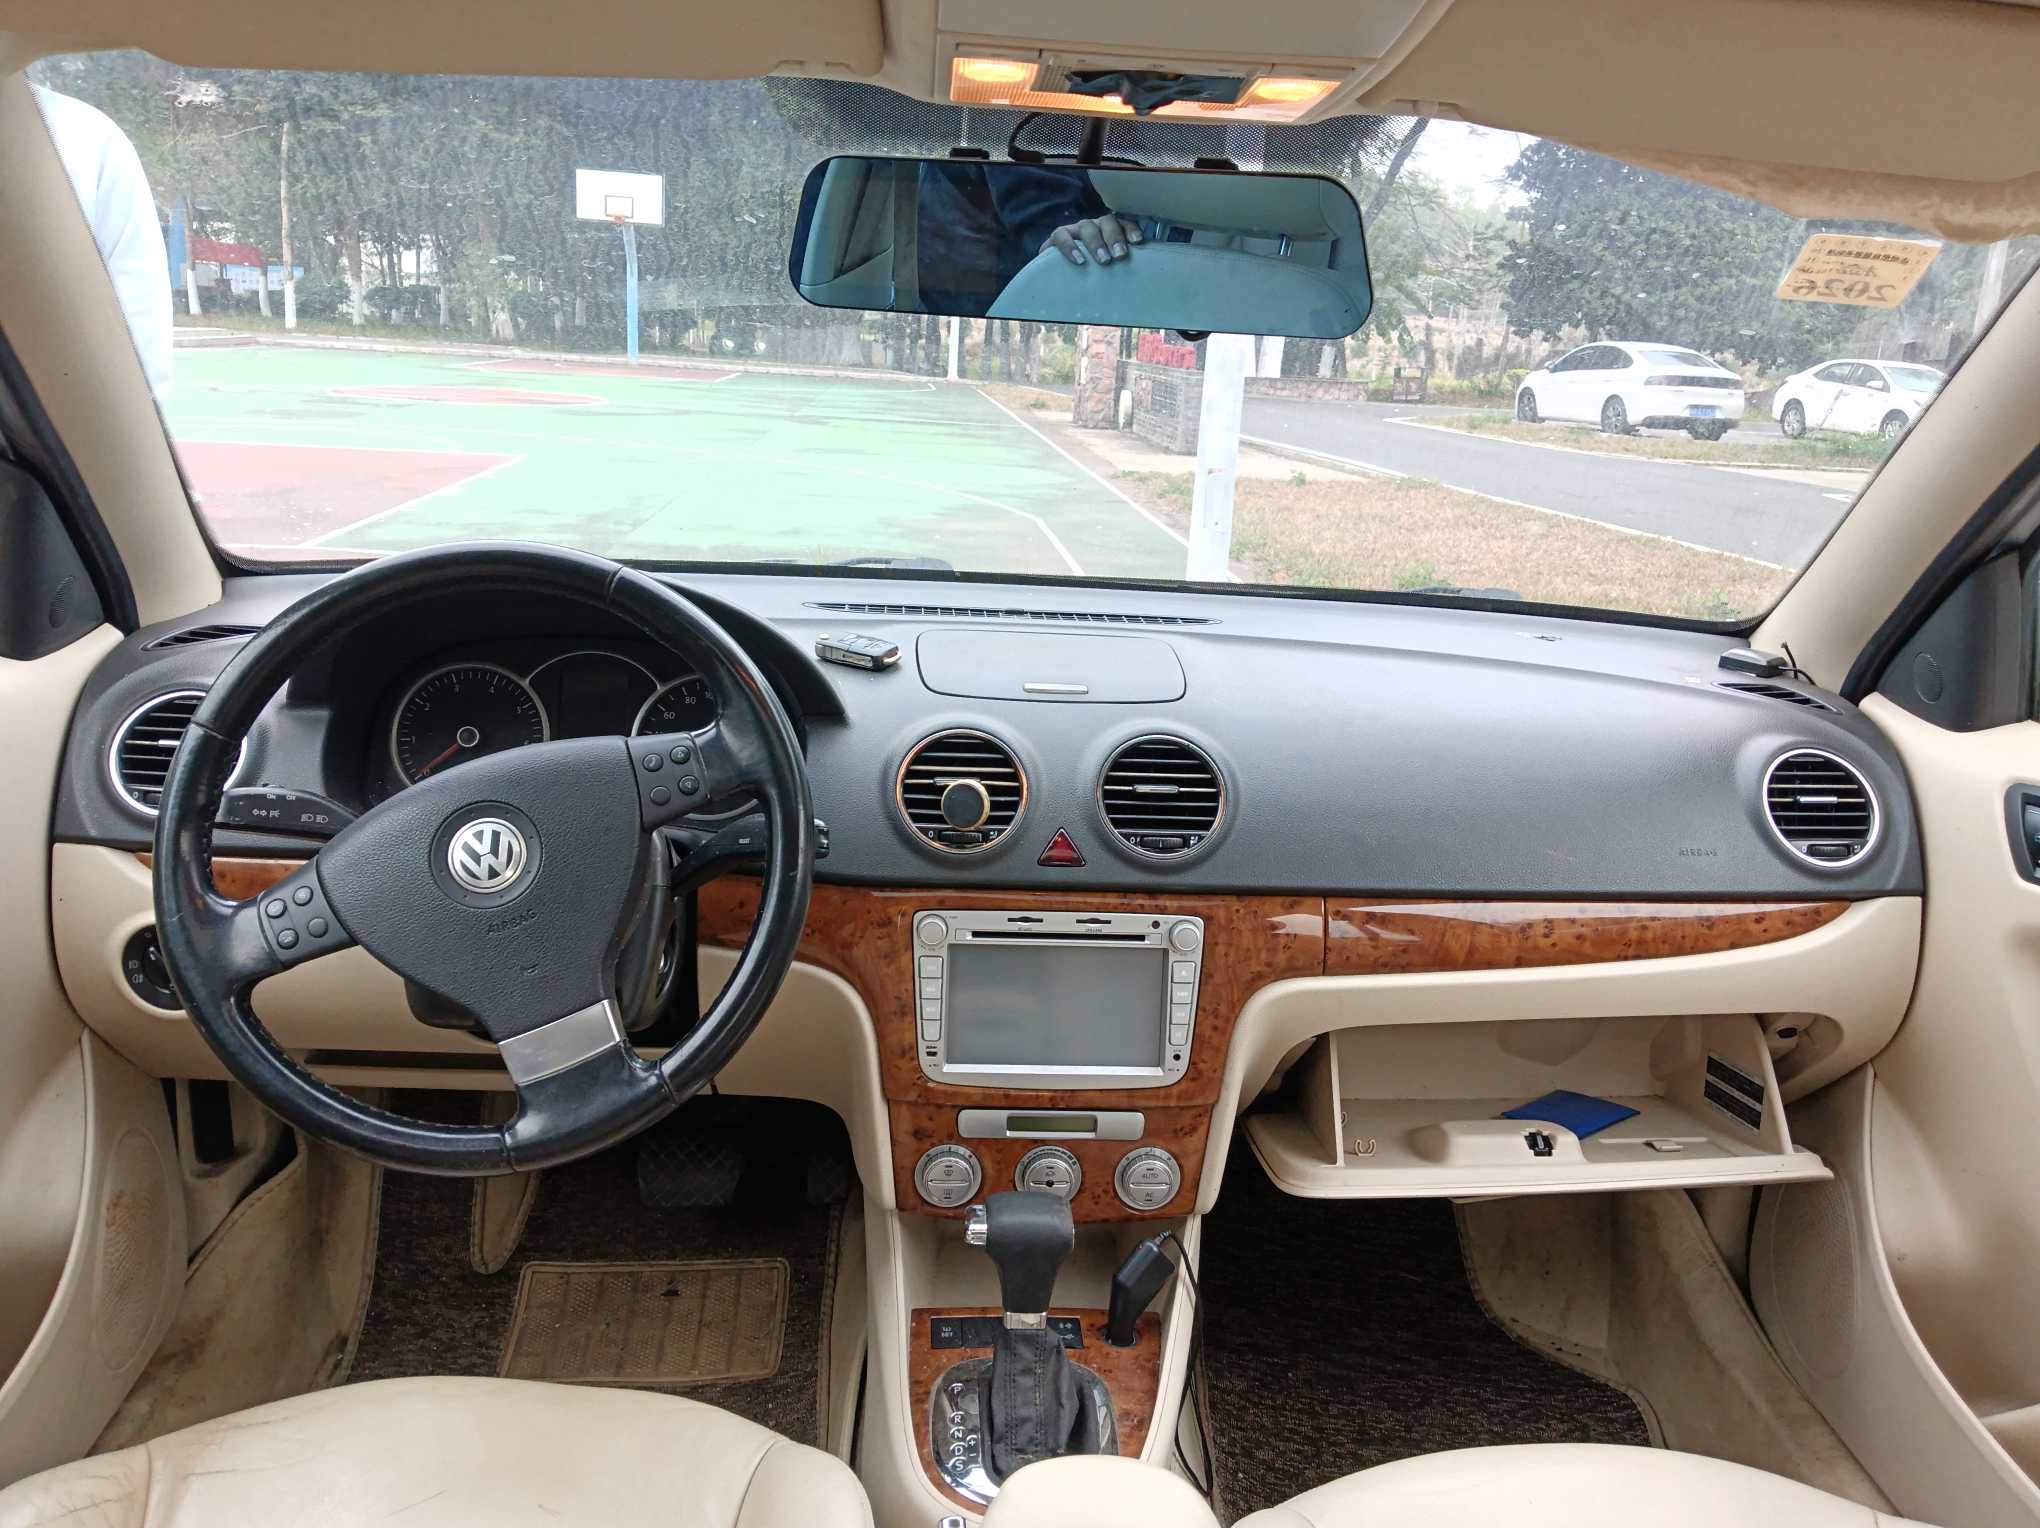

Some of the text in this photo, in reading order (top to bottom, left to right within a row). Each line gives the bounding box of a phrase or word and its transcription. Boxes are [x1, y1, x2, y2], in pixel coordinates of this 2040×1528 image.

[489, 686, 495, 694] 4
[664, 712, 675, 720] 60
[487, 909, 538, 936] AIRBAG
[954, 1415, 961, 1423] R
[954, 1431, 963, 1440] N
[955, 1446, 964, 1456] D
[955, 1460, 964, 1471] S
